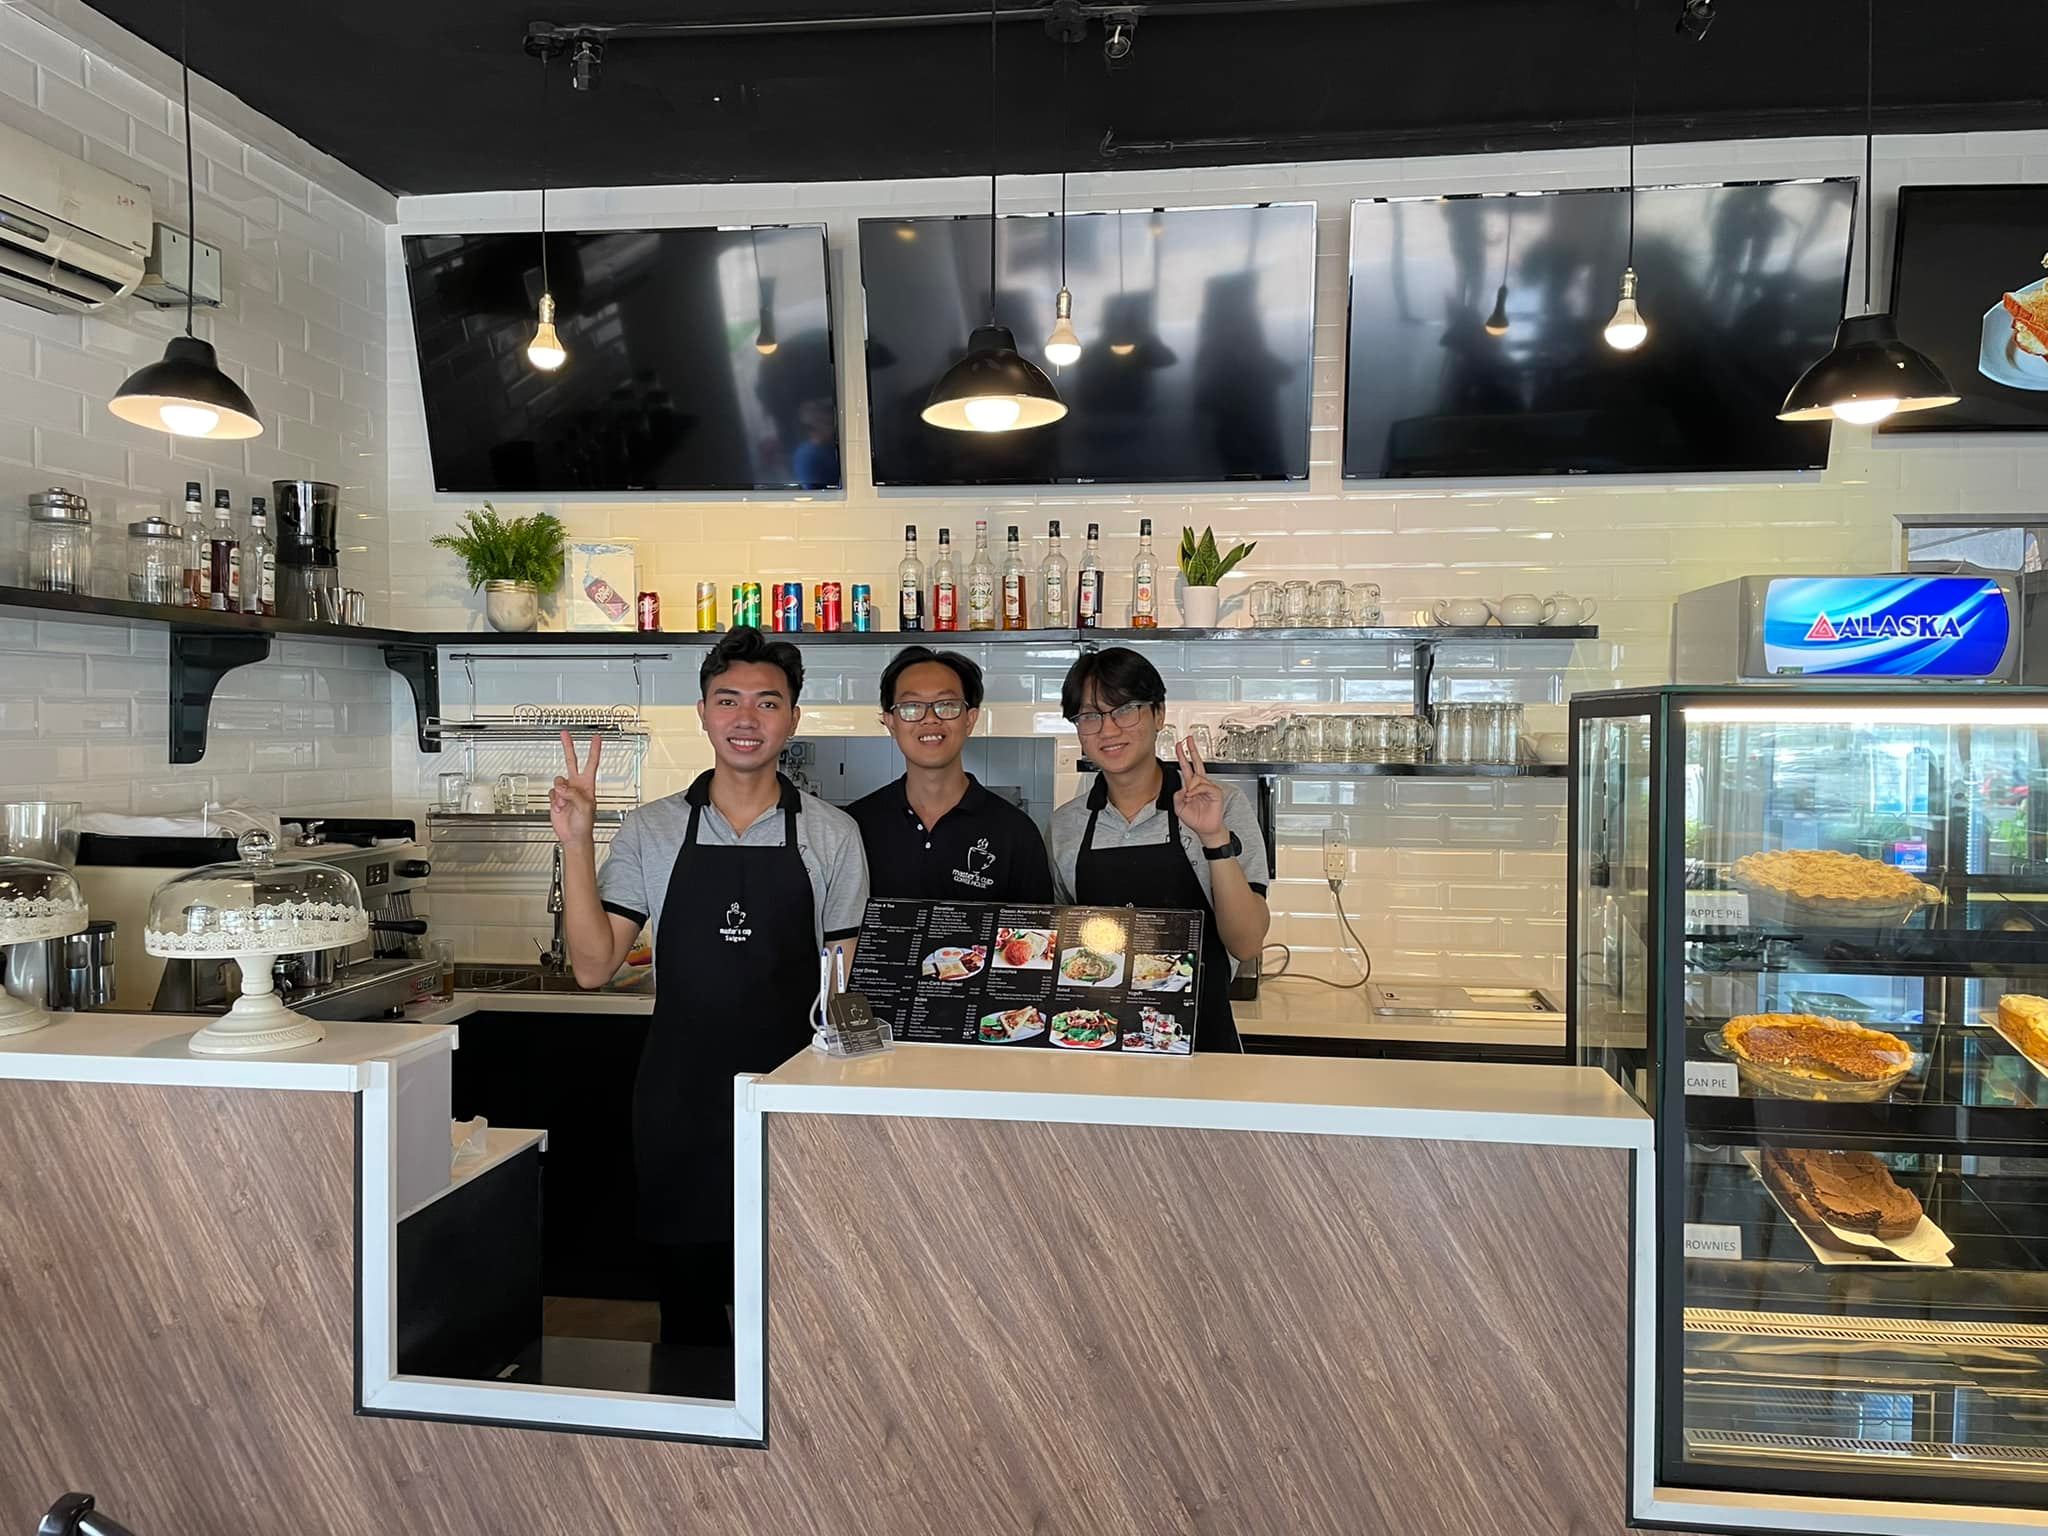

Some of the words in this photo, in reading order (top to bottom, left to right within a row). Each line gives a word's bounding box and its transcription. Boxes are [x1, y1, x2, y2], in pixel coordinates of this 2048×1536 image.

[1840, 615, 1962, 638] ALASKA
[1690, 908, 1723, 919] APPLE
[1726, 909, 1743, 919] PIE
[1711, 1079, 1727, 1089] PIE
[1685, 1239, 1737, 1252] ROWNIES
